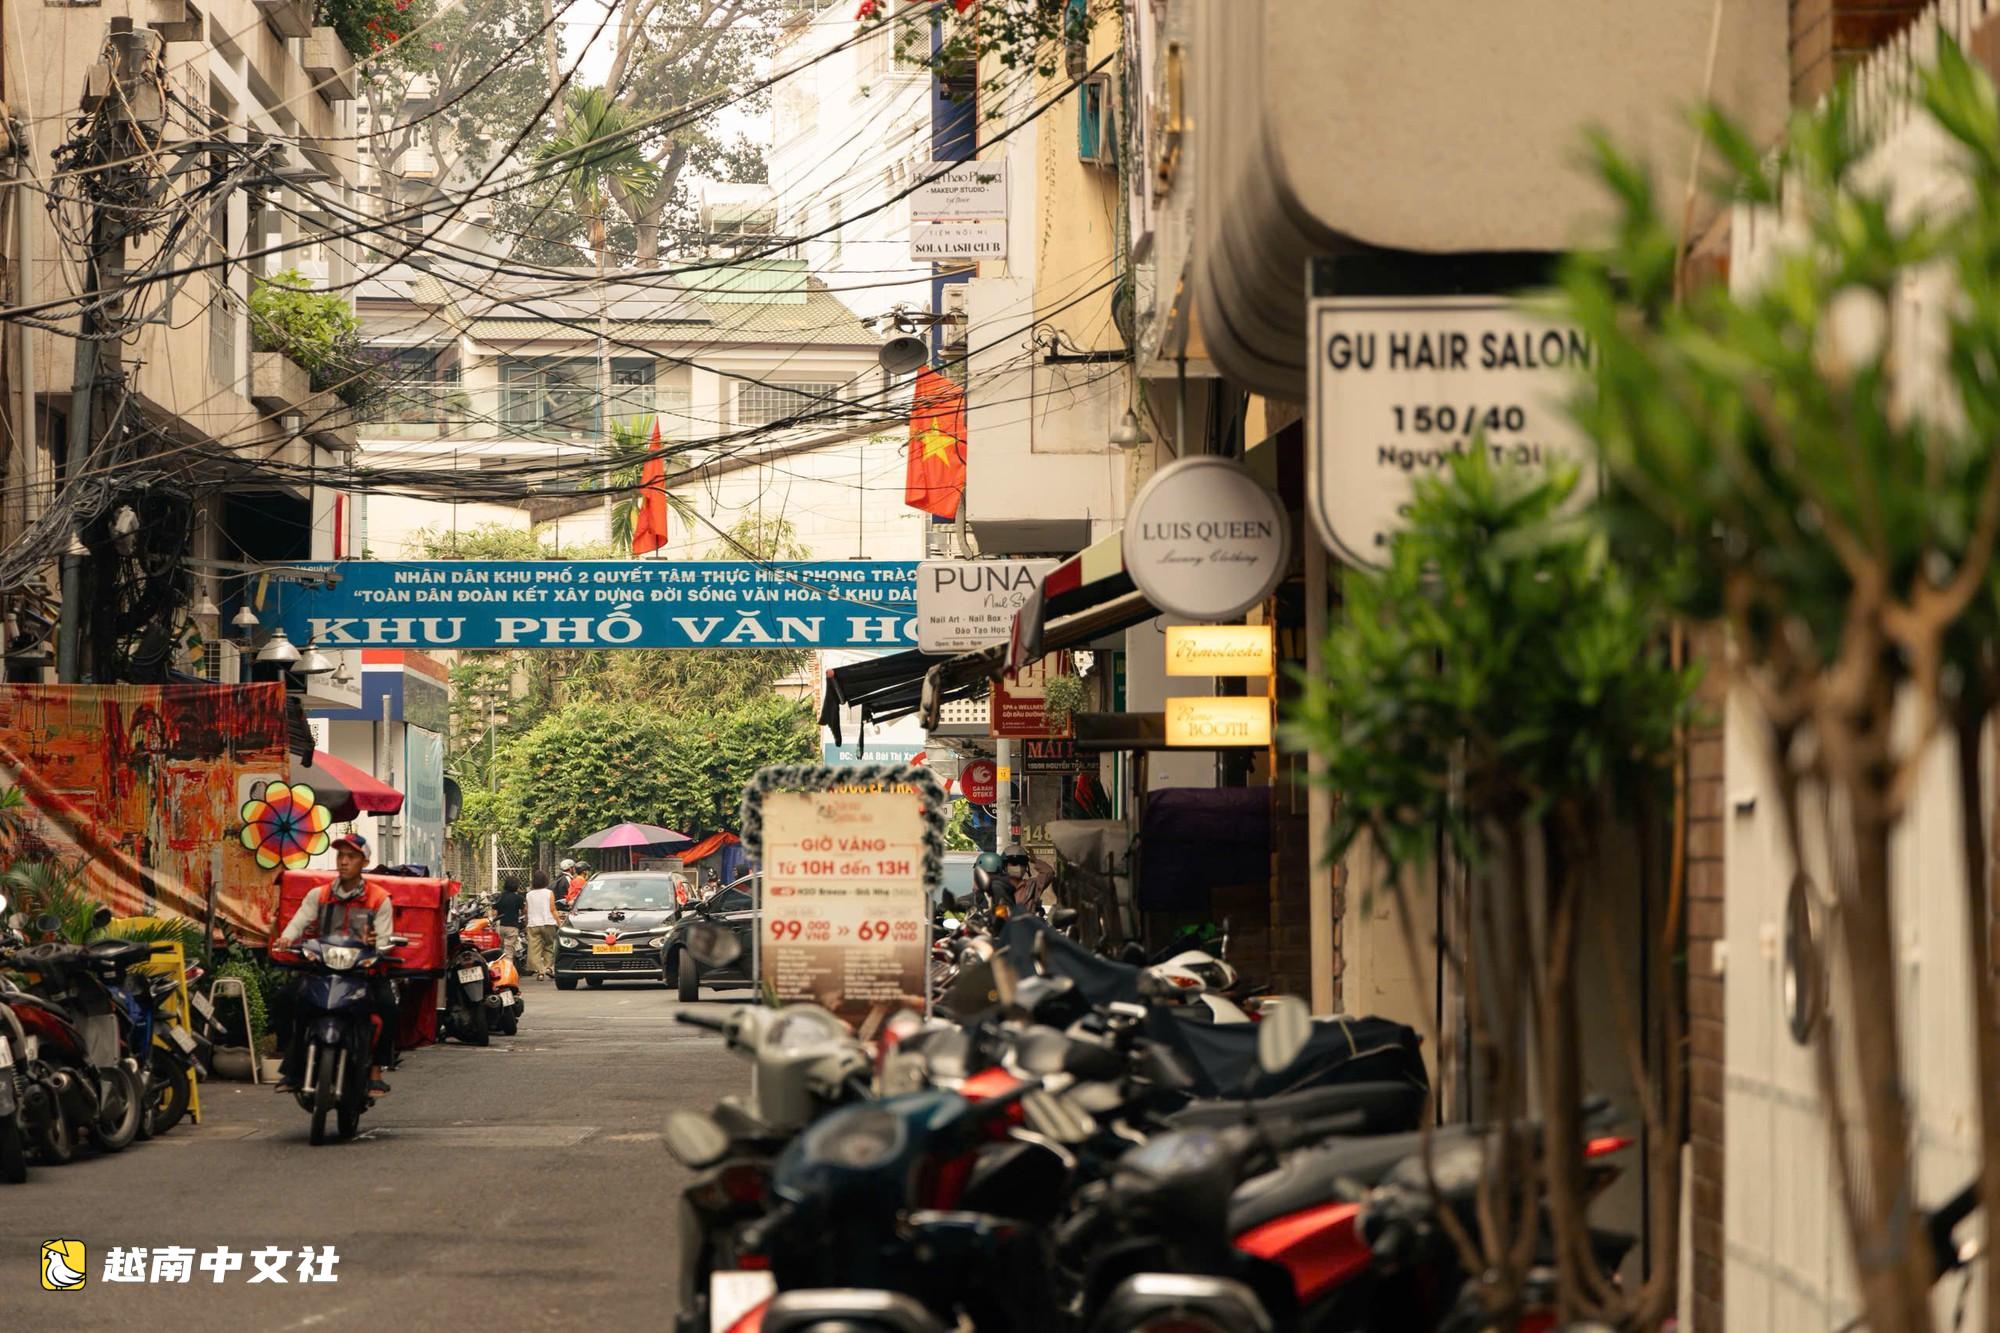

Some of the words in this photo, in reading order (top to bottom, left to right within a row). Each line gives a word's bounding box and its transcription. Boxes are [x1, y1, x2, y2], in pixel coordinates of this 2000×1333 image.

[916, 243, 942, 252] SOLA
[945, 242, 972, 252] LASH
[974, 242, 1000, 252] CLUB
[1328, 332, 1375, 370] GU
[1389, 331, 1469, 370] HAIR
[1481, 329, 1590, 370] SALON
[1391, 405, 1526, 435] 150/40
[1143, 522, 1191, 541] LUIS
[1196, 520, 1272, 543] QUEEN
[394, 568, 446, 584] NHÂN
[452, 568, 488, 584] DÂN
[494, 571, 531, 583] KHU
[536, 566, 572, 584] PHỐ
[578, 572, 589, 584] 2
[593, 566, 653, 584] QUYẾT
[658, 568, 696, 583] TÂM
[701, 568, 750, 585] THỰC
[756, 568, 798, 585] HIỆN
[803, 570, 866, 582] PHONG
[934, 566, 1036, 593] PUNA
[416, 588, 453, 602] DÂN
[458, 588, 507, 602] ĐOÀN
[513, 585, 548, 602] KẾT
[554, 588, 590, 602] XÂY
[595, 587, 644, 604] DỰNG
[650, 587, 682, 602] ĐỜI
[688, 585, 737, 602] SỐNG
[742, 587, 779, 602] VĂN
[846, 590, 883, 601] KHU
[307, 617, 466, 644] KHU
[495, 602, 642, 644] PHỐ
[672, 610, 826, 643] VĂN
[930, 616, 946, 624] Nail
[948, 616, 960, 624] Art
[987, 614, 1000, 622] Box
[801, 836, 833, 852] GIỜ
[838, 836, 886, 852] VÀNG
[801, 861, 834, 875] 10H
[840, 859, 870, 875] đến
[876, 861, 910, 875] 13H
[770, 920, 802, 940] 99
[858, 920, 890, 940] 69
